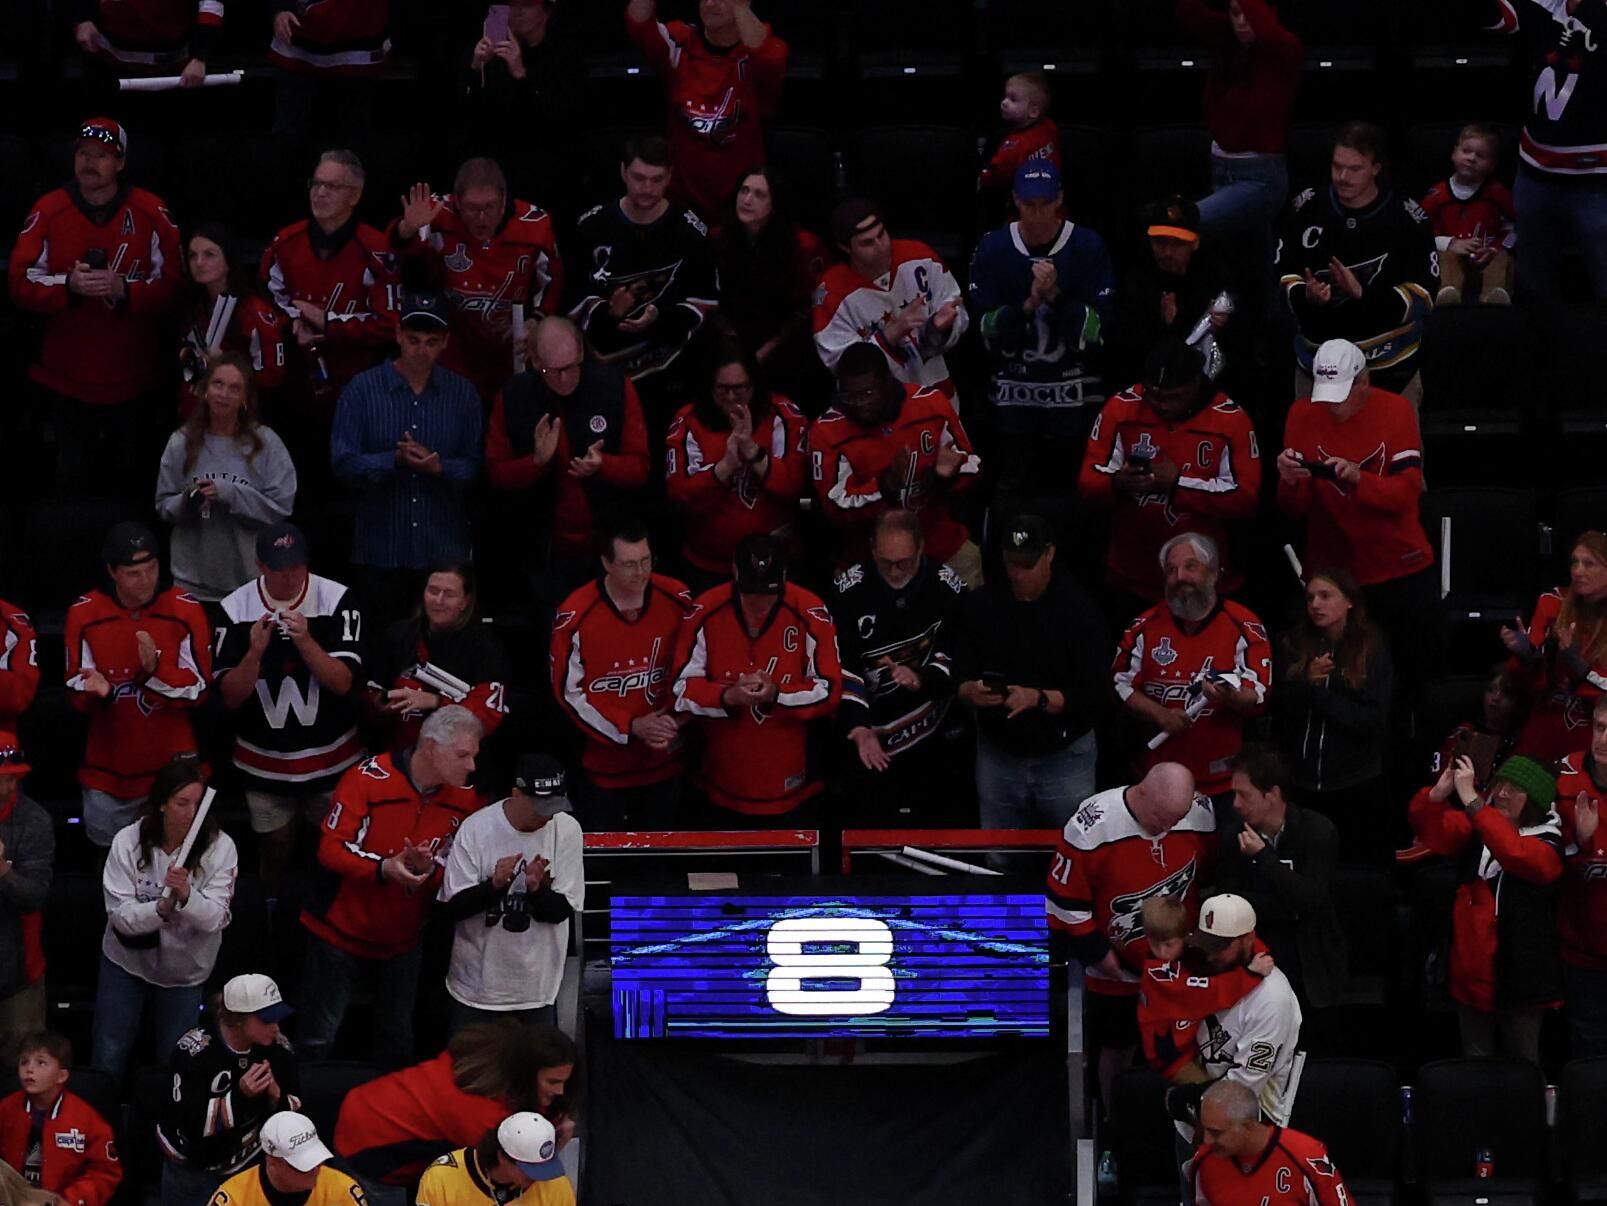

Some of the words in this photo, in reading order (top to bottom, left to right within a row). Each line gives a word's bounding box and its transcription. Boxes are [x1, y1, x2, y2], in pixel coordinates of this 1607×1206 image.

[1302, 226, 1323, 248] C
[1429, 251, 1441, 277] 8
[915, 266, 929, 293] C
[921, 430, 936, 456] C
[1197, 441, 1214, 469] C
[813, 450, 824, 481] 8
[341, 609, 361, 642] 17
[784, 625, 799, 651] C
[858, 614, 877, 639] C
[254, 674, 321, 729] W
[327, 801, 344, 831] 8
[1051, 851, 1072, 885] 21
[767, 919, 896, 1016] 8
[1185, 976, 1210, 989] 8
[1246, 1041, 1274, 1073] 2
[172, 1072, 182, 1103] 8
[211, 1069, 232, 1094] C
[1276, 1167, 1292, 1194] C
